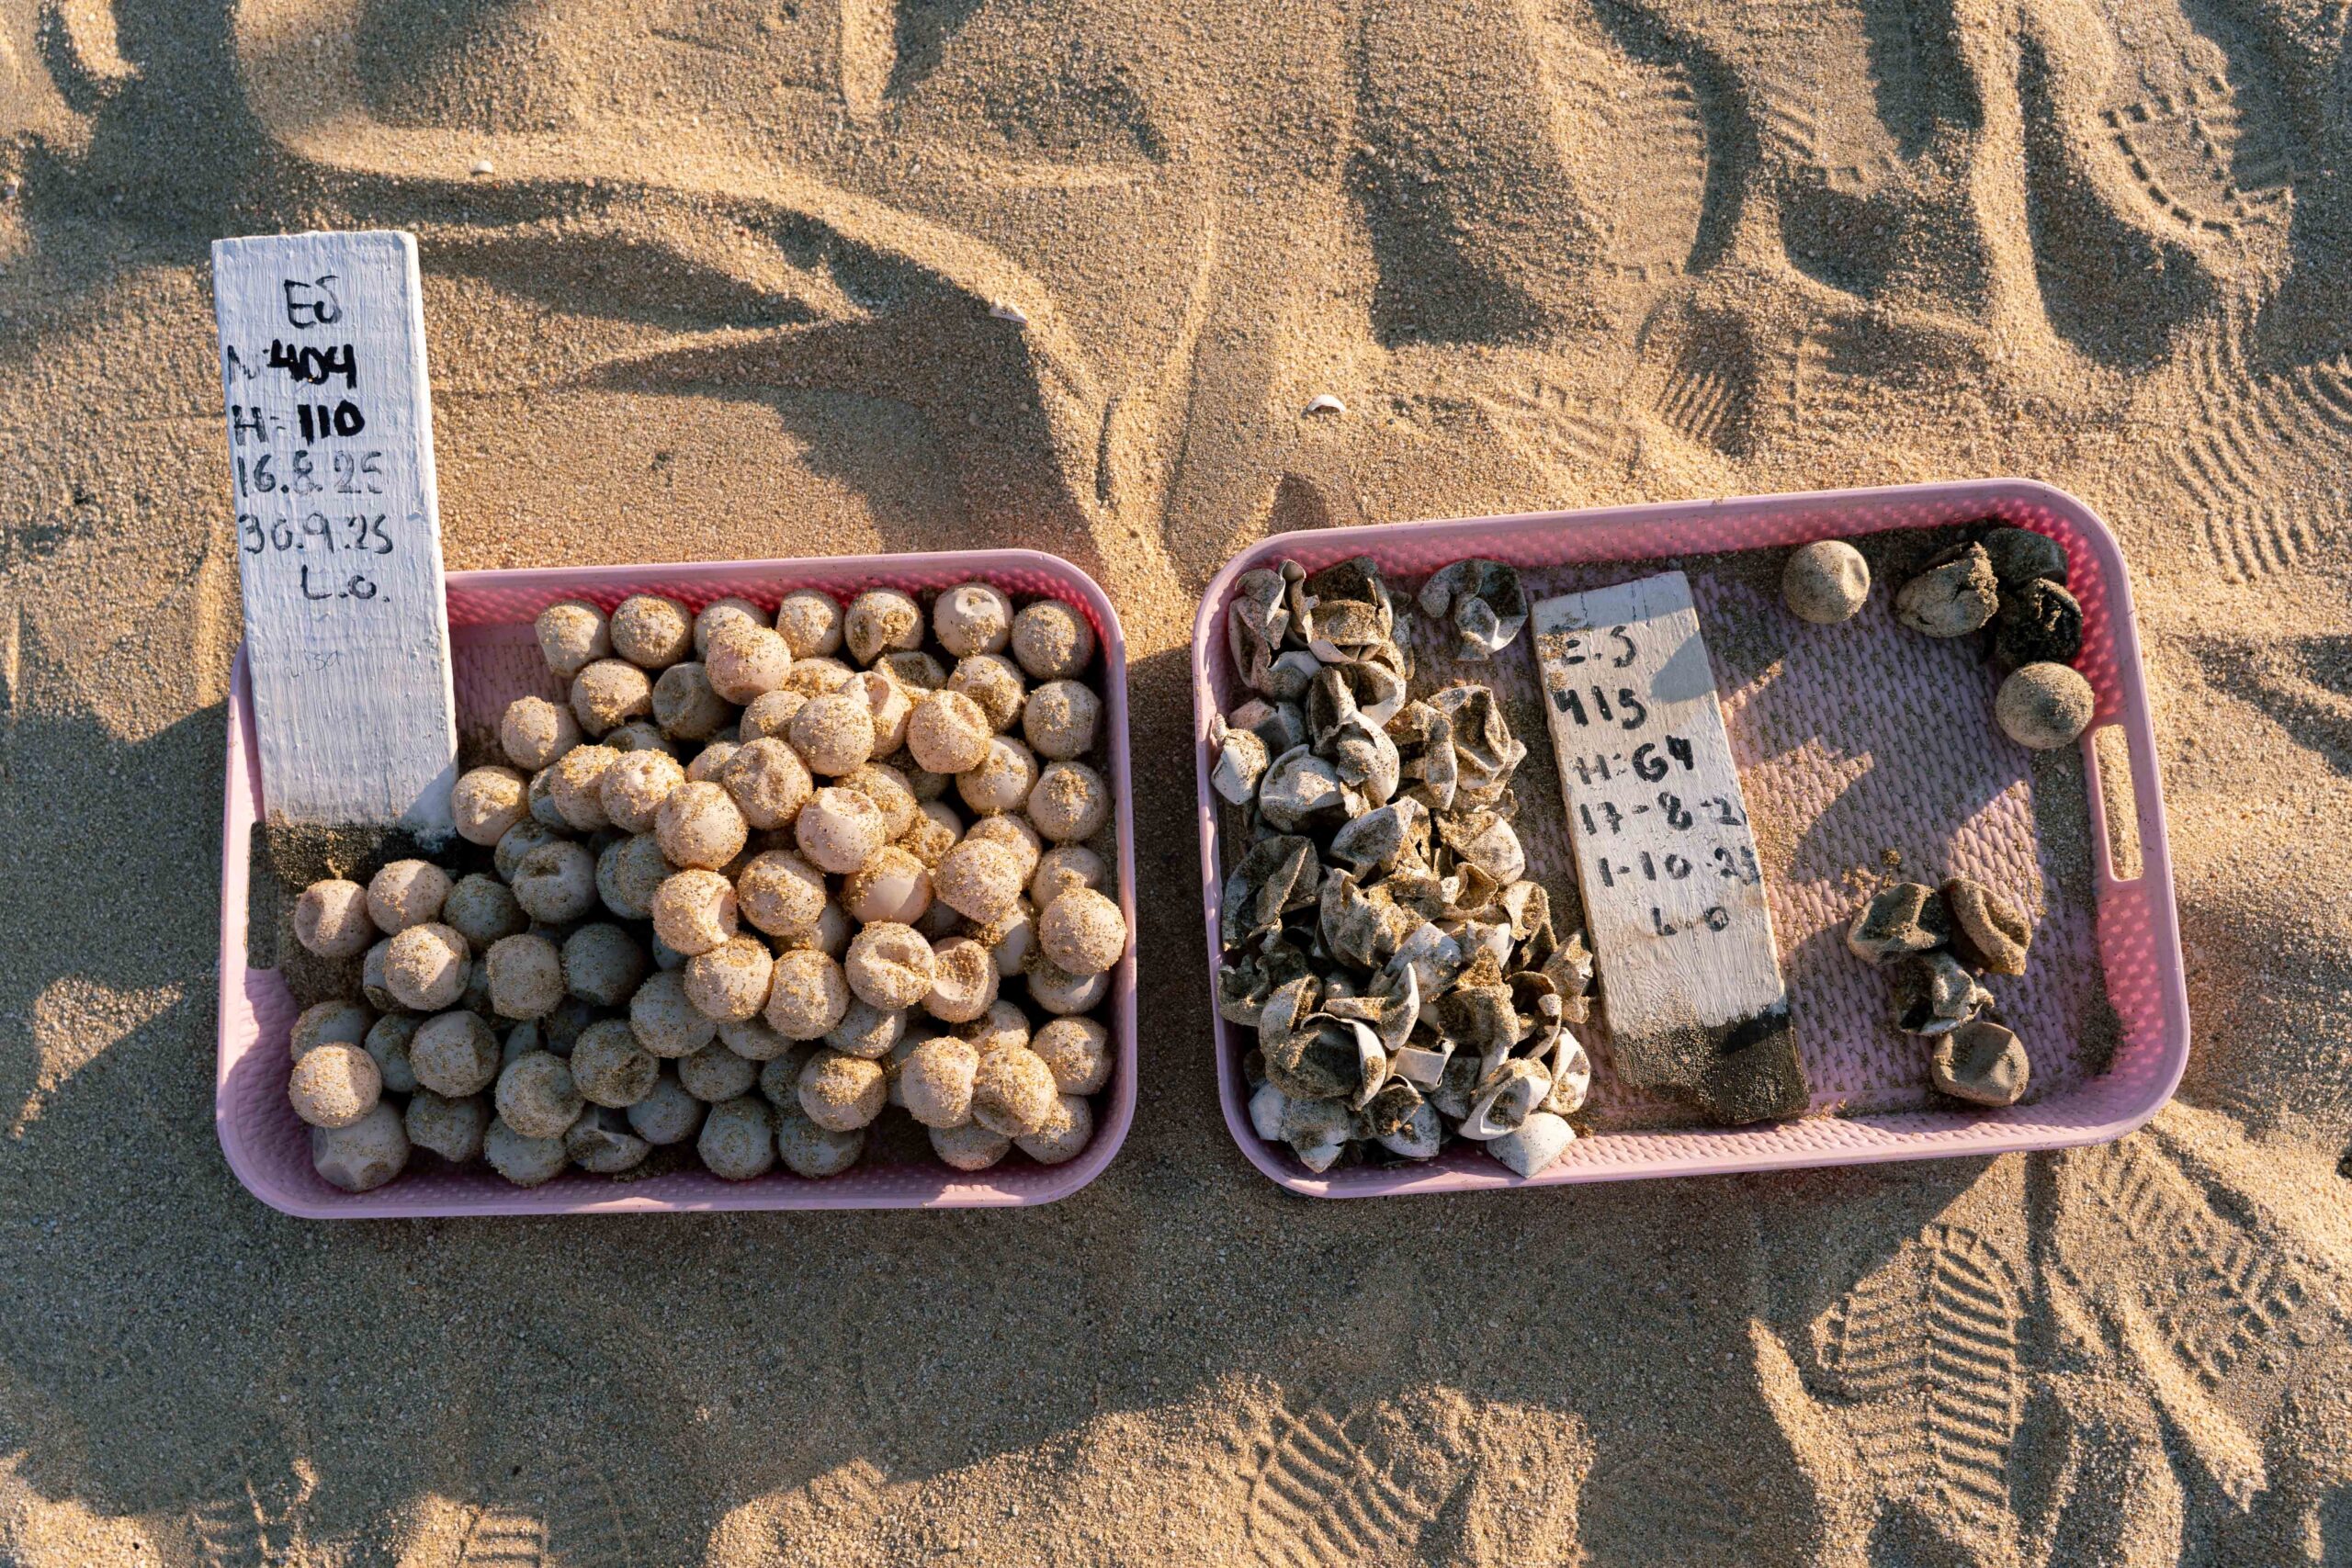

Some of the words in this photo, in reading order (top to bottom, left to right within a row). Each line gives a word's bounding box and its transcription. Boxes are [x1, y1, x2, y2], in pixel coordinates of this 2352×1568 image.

[238, 512, 393, 554] 30.9.25
[1553, 685, 1647, 729] 415
[1579, 792, 1747, 836] 17-8-2
